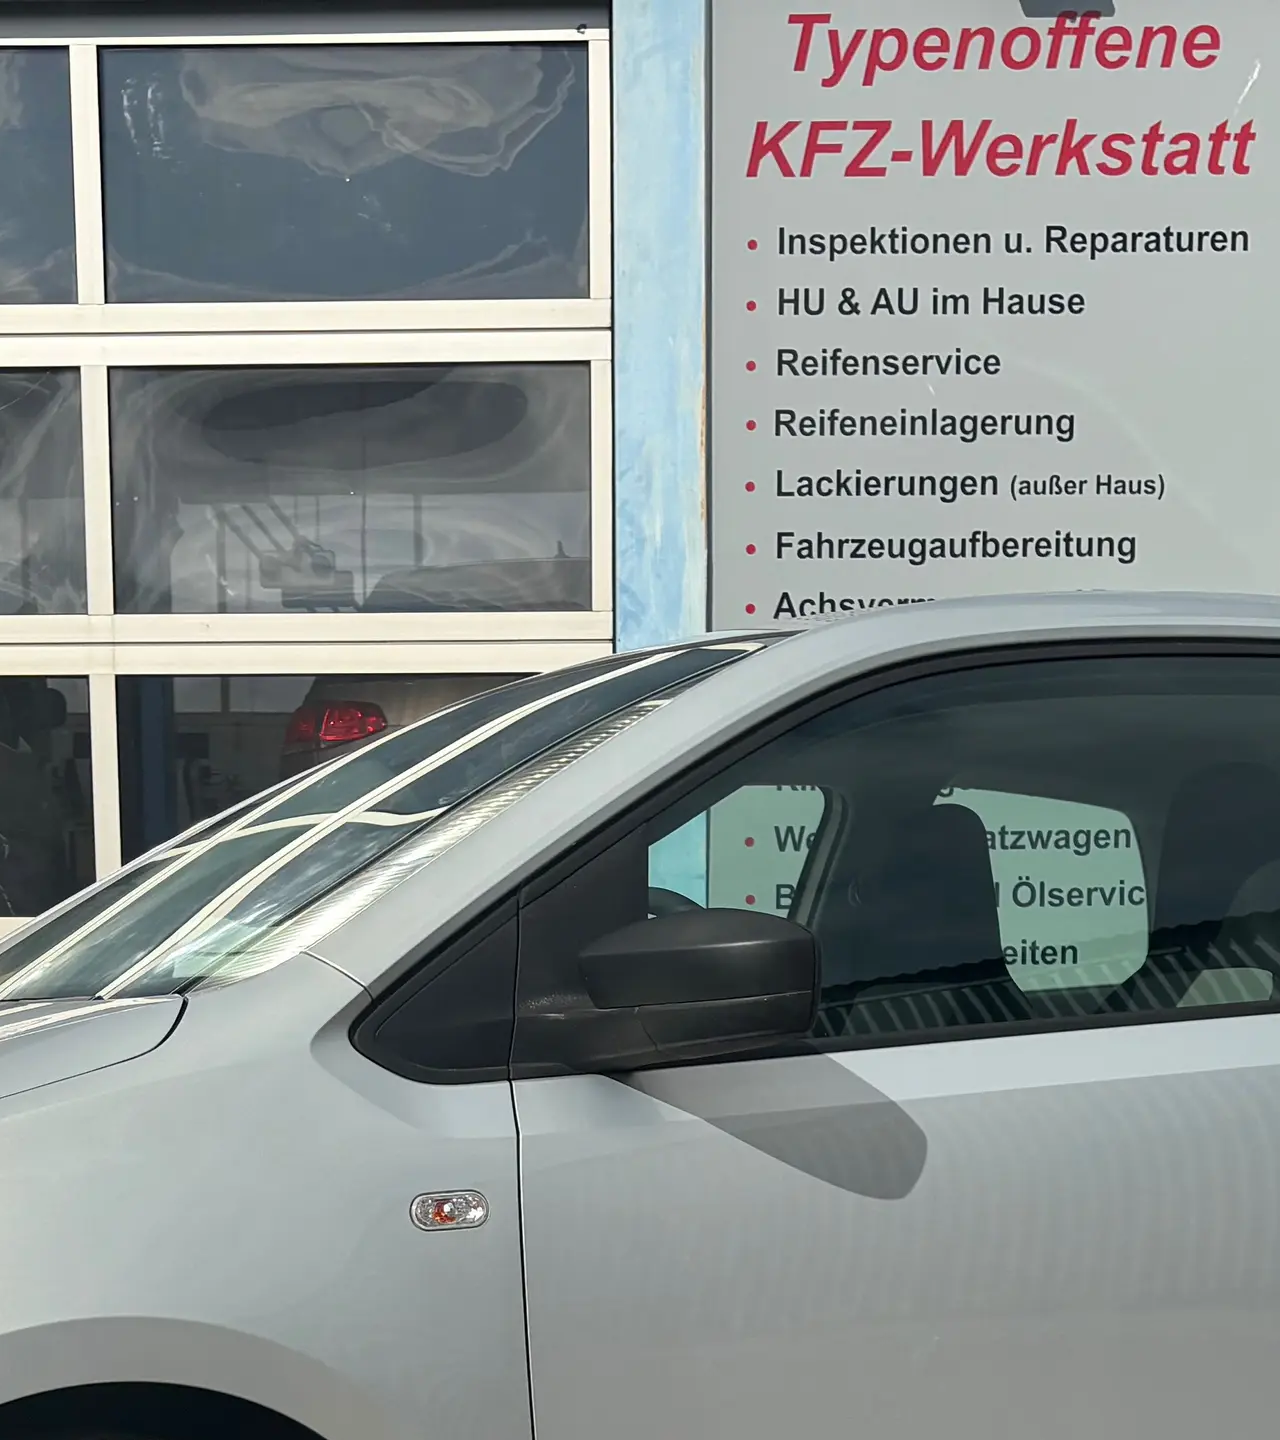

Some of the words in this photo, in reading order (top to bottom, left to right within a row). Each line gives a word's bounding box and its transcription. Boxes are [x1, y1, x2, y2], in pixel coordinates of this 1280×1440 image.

[787, 10, 1222, 88] Typenoffene
[745, 118, 1257, 179] KFZ-Werkstatt
[777, 226, 992, 262] Inspektionen
[1004, 232, 1032, 254] u.
[1045, 225, 1250, 261] Reparaturen
[777, 287, 825, 316] HU
[837, 287, 862, 316] &
[870, 287, 919, 316] AU
[932, 286, 970, 315] im
[982, 286, 1086, 315] Hause
[776, 347, 1001, 377] Reifenservice
[774, 406, 1076, 444] Reifeneinlagerung
[776, 468, 999, 504] Lackierungen
[1009, 473, 1088, 502] (außer
[1095, 473, 1166, 502] Haus)
[776, 529, 1137, 567] Fahrzeugaufbereitung
